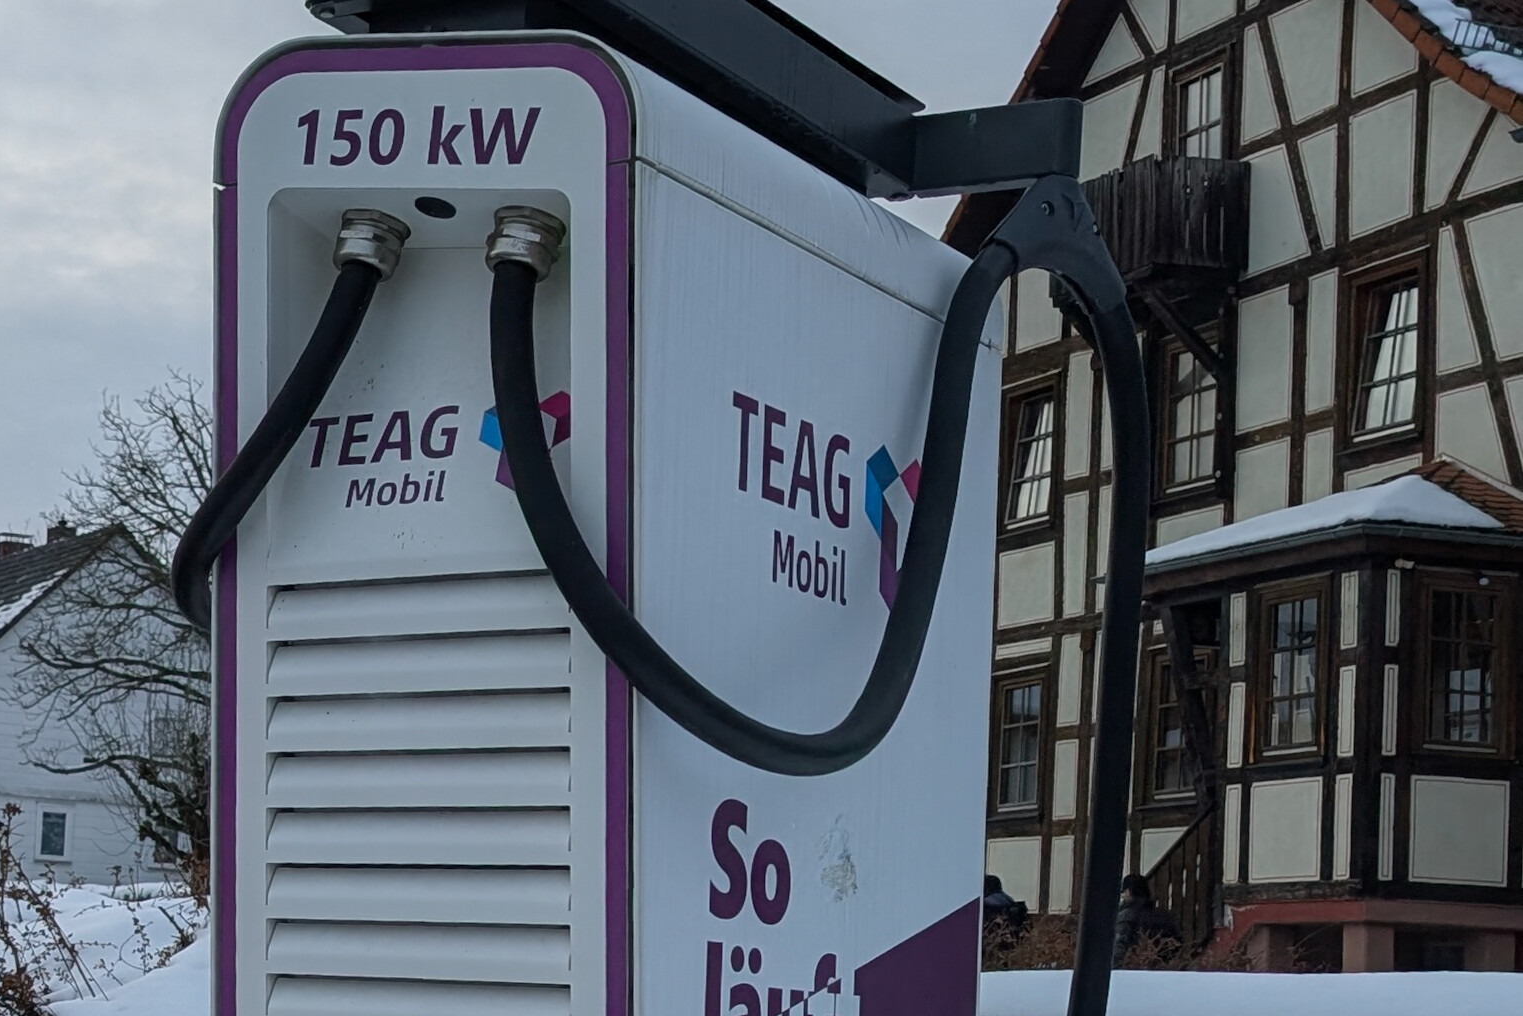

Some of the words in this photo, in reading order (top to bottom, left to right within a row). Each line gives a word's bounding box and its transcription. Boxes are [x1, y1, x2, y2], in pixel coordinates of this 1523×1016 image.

[297, 107, 406, 167] 150
[426, 105, 542, 166] kW
[309, 405, 460, 468] TEAG
[732, 390, 851, 529] TEAG
[345, 470, 446, 508] Mobil
[772, 529, 847, 606] Mobil
[709, 798, 791, 925] So
